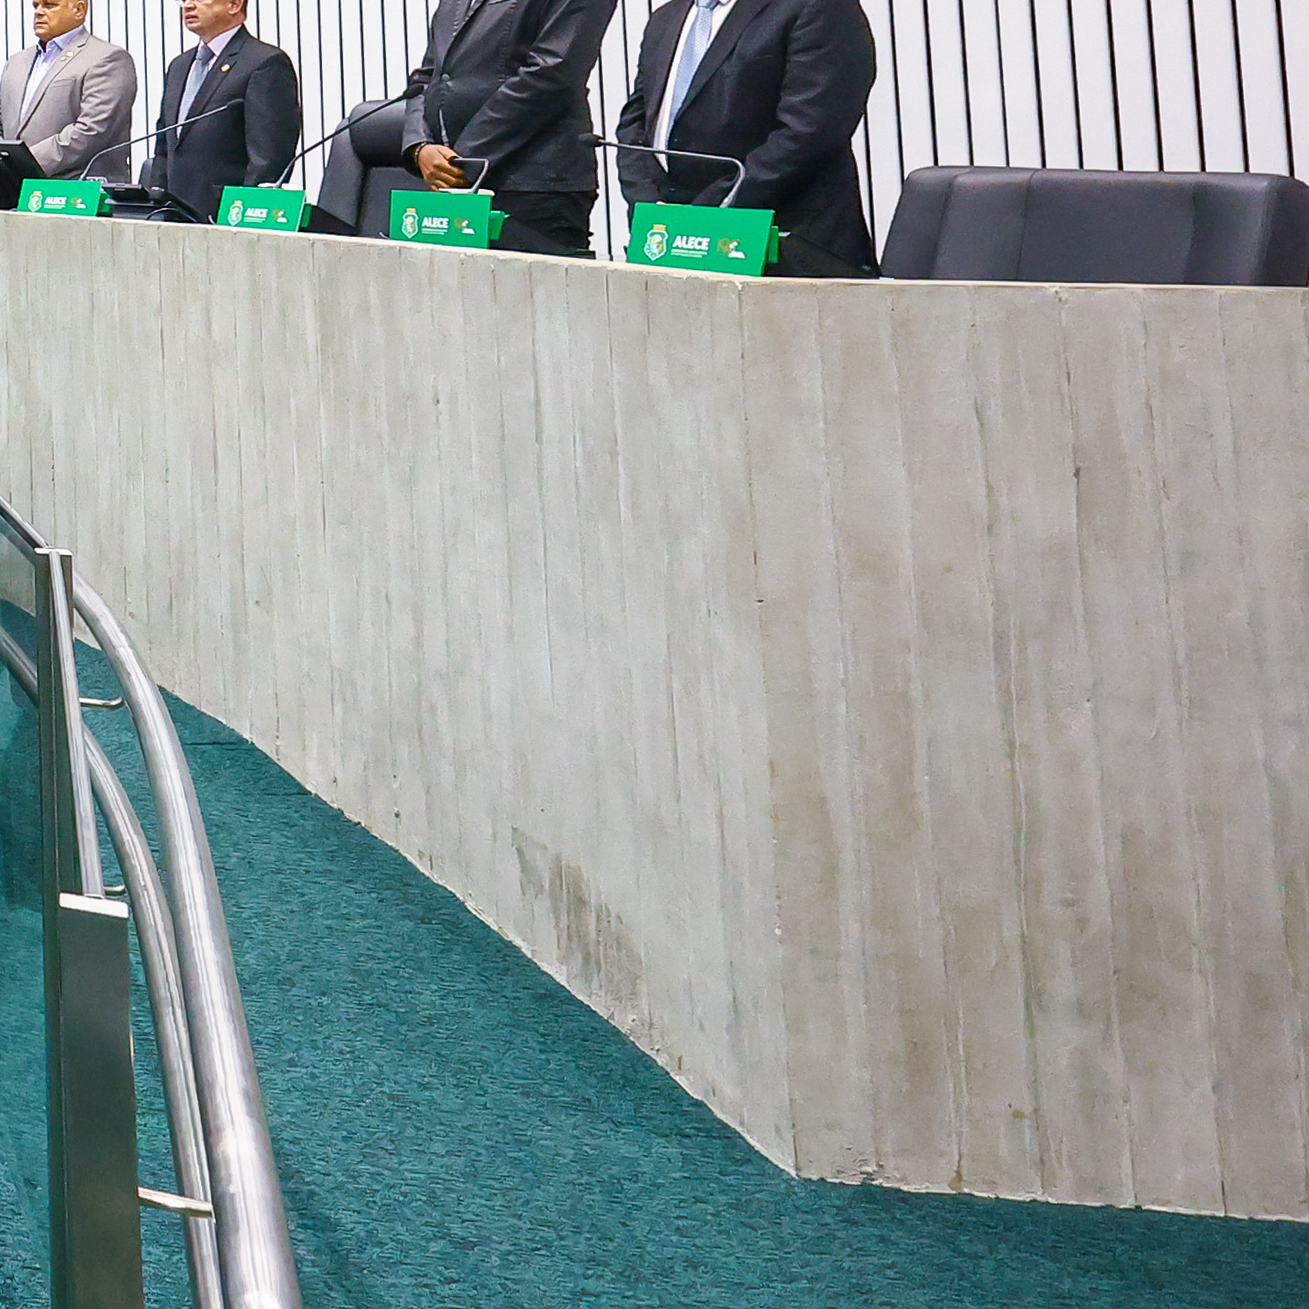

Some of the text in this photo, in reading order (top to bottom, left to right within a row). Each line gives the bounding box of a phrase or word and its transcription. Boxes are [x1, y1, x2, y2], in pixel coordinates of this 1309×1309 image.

[244, 207, 269, 218] ALECE
[422, 216, 450, 229] ALECE
[671, 235, 711, 251] ALECE
